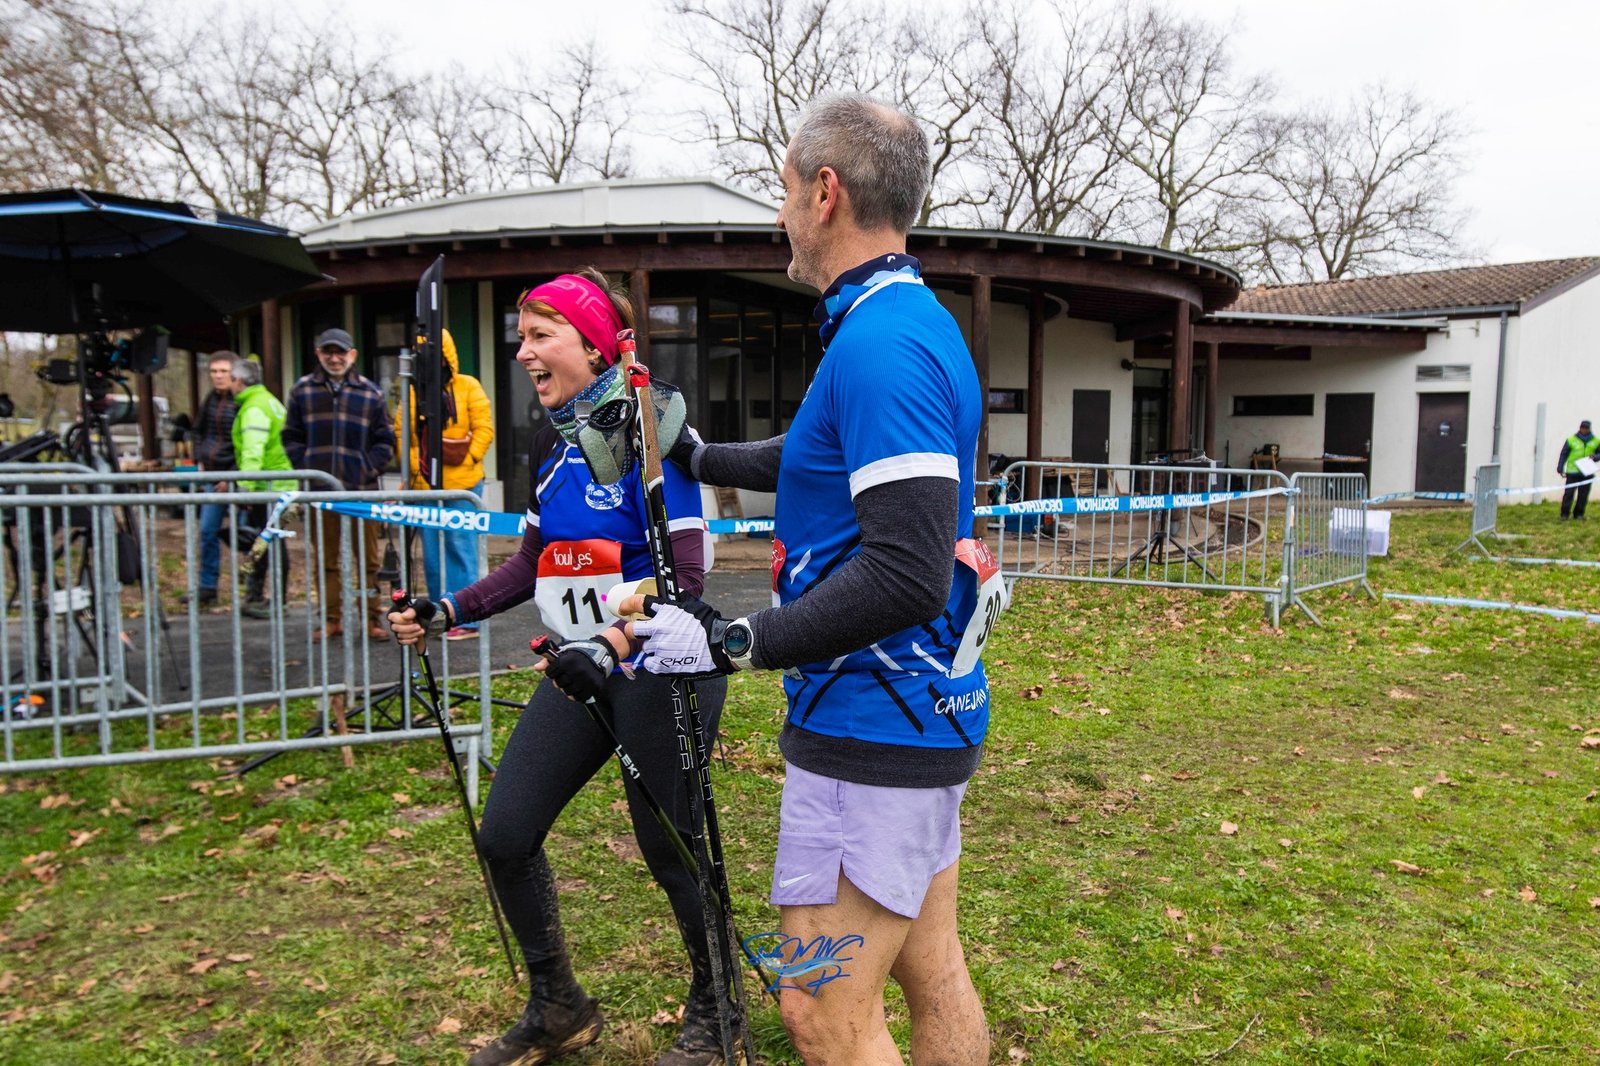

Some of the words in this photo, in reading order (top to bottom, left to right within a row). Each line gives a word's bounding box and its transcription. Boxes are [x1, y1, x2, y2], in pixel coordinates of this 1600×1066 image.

[1009, 498, 1063, 514] DECATHLON
[1076, 497, 1119, 512] DECATHLON
[1130, 495, 1165, 510] DECATHLON
[370, 503, 490, 532] DECATHLON
[561, 588, 605, 625] 11
[671, 679, 690, 770] MAKER
[615, 744, 641, 780] LEKI
